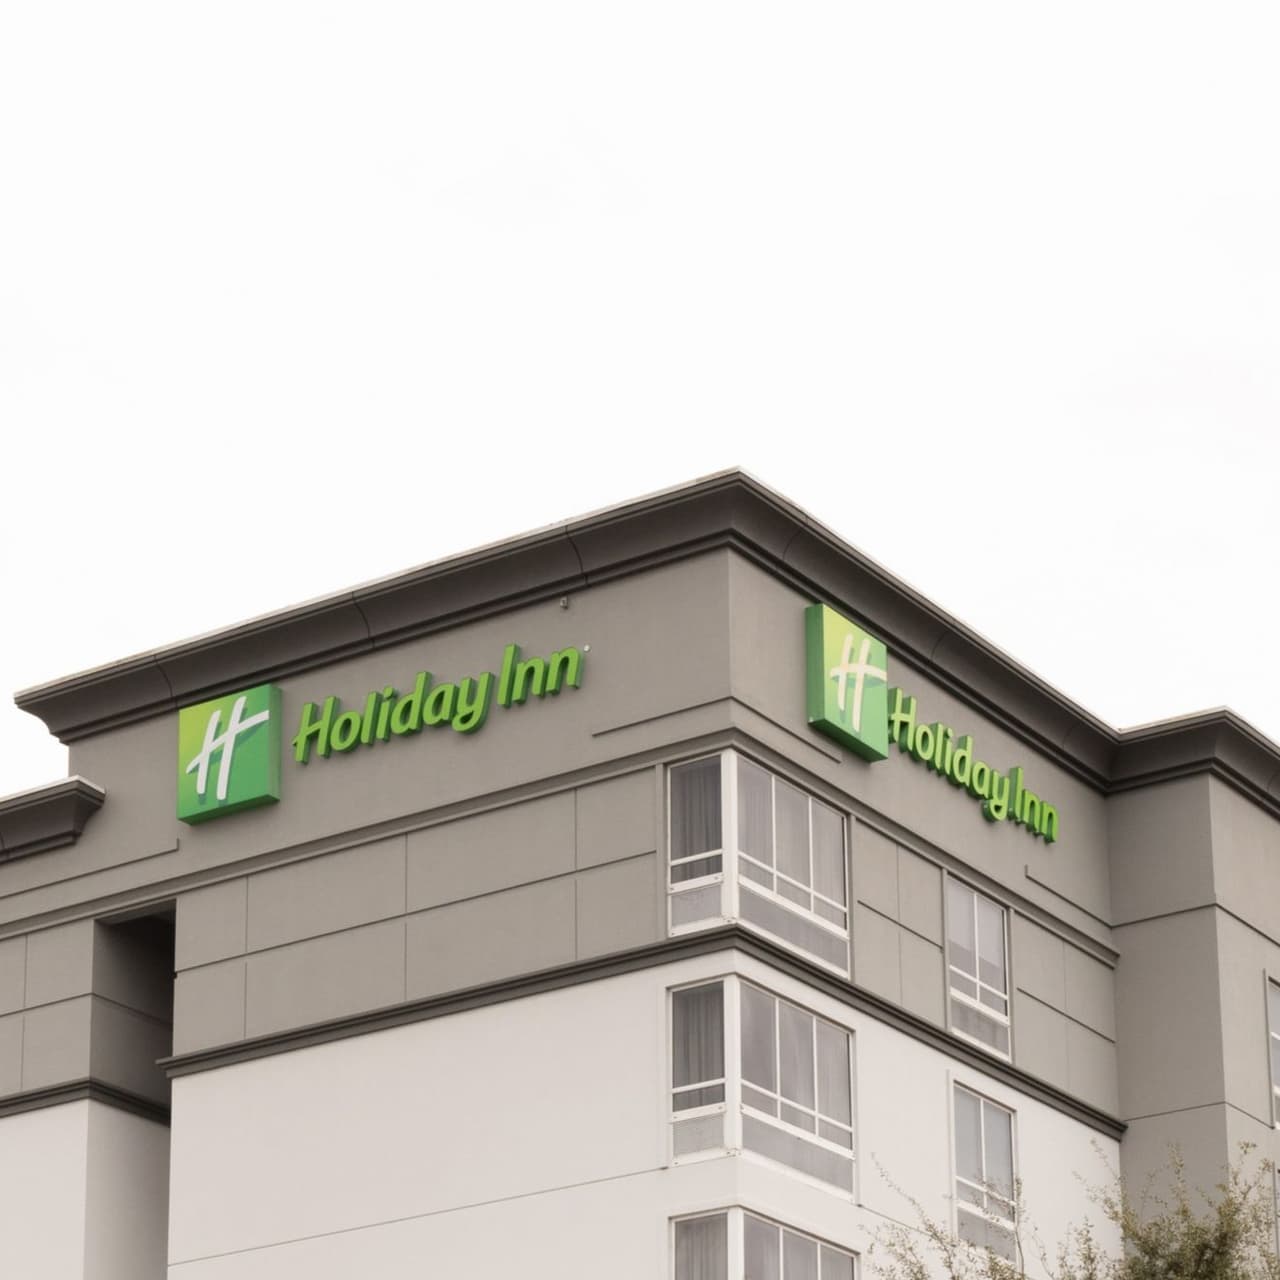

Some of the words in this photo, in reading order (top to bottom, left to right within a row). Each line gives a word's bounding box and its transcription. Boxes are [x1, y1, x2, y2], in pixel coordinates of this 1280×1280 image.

[292, 671, 494, 764] Holiday
[497, 643, 583, 707] Inn
[888, 688, 1010, 822] Holiday
[1008, 767, 1058, 843] Inn
